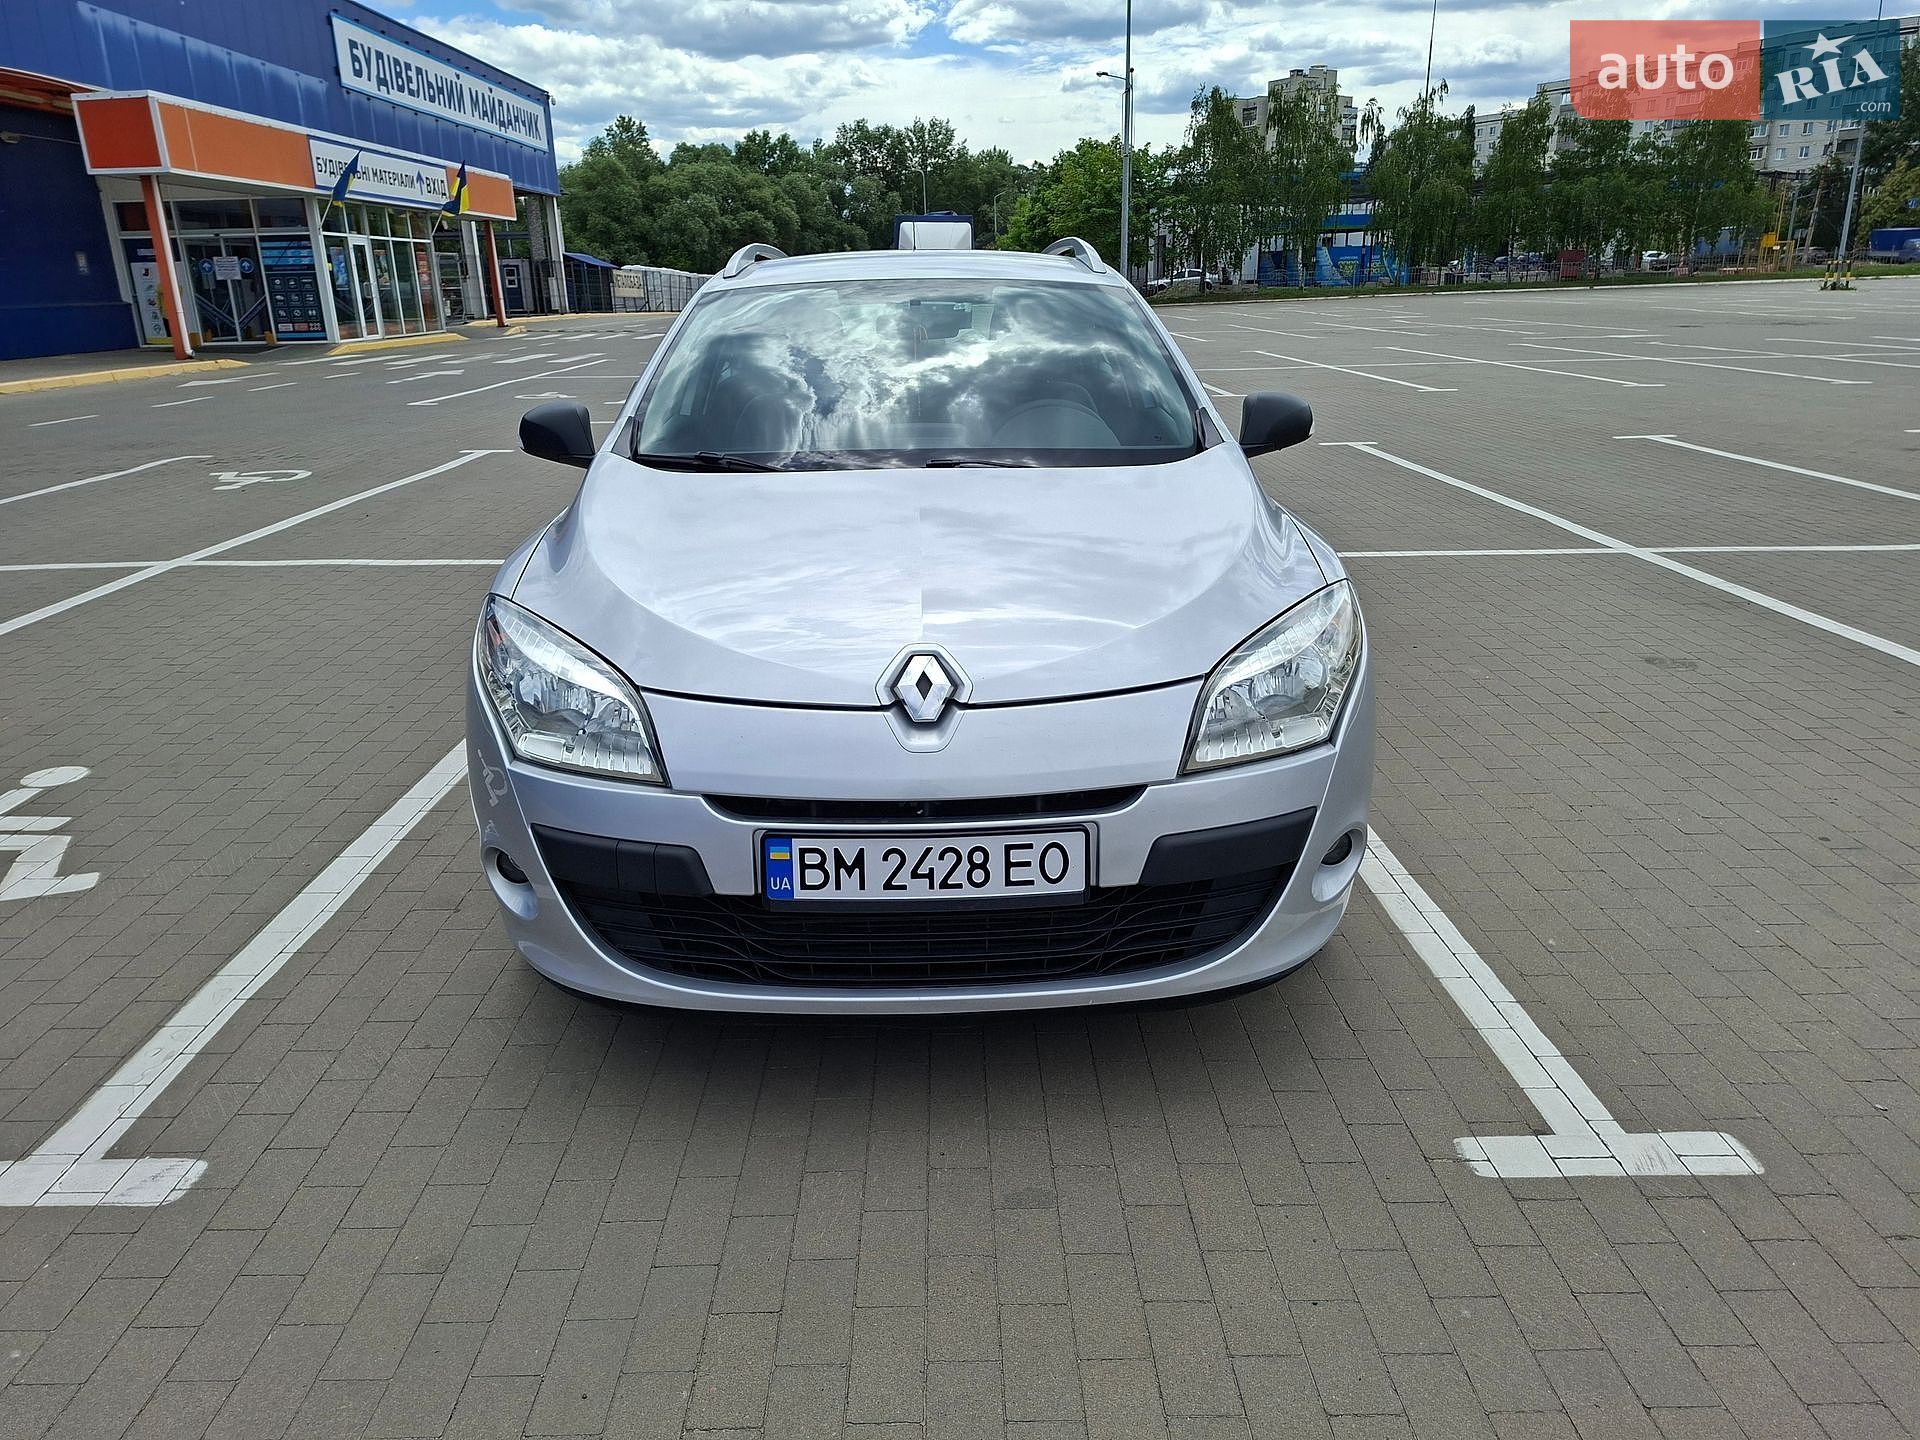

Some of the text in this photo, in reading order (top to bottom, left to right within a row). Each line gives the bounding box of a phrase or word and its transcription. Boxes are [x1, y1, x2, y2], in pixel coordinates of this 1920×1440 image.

[348, 38, 542, 142] БУДІВЕЛЬНИЙ МАЙДАНЧИК
[315, 156, 448, 199] БУДІВЬНІ МАТЕРІАЛИ ВХІД
[770, 877, 791, 891] UA
[798, 840, 1070, 891] BM 2428 EO
